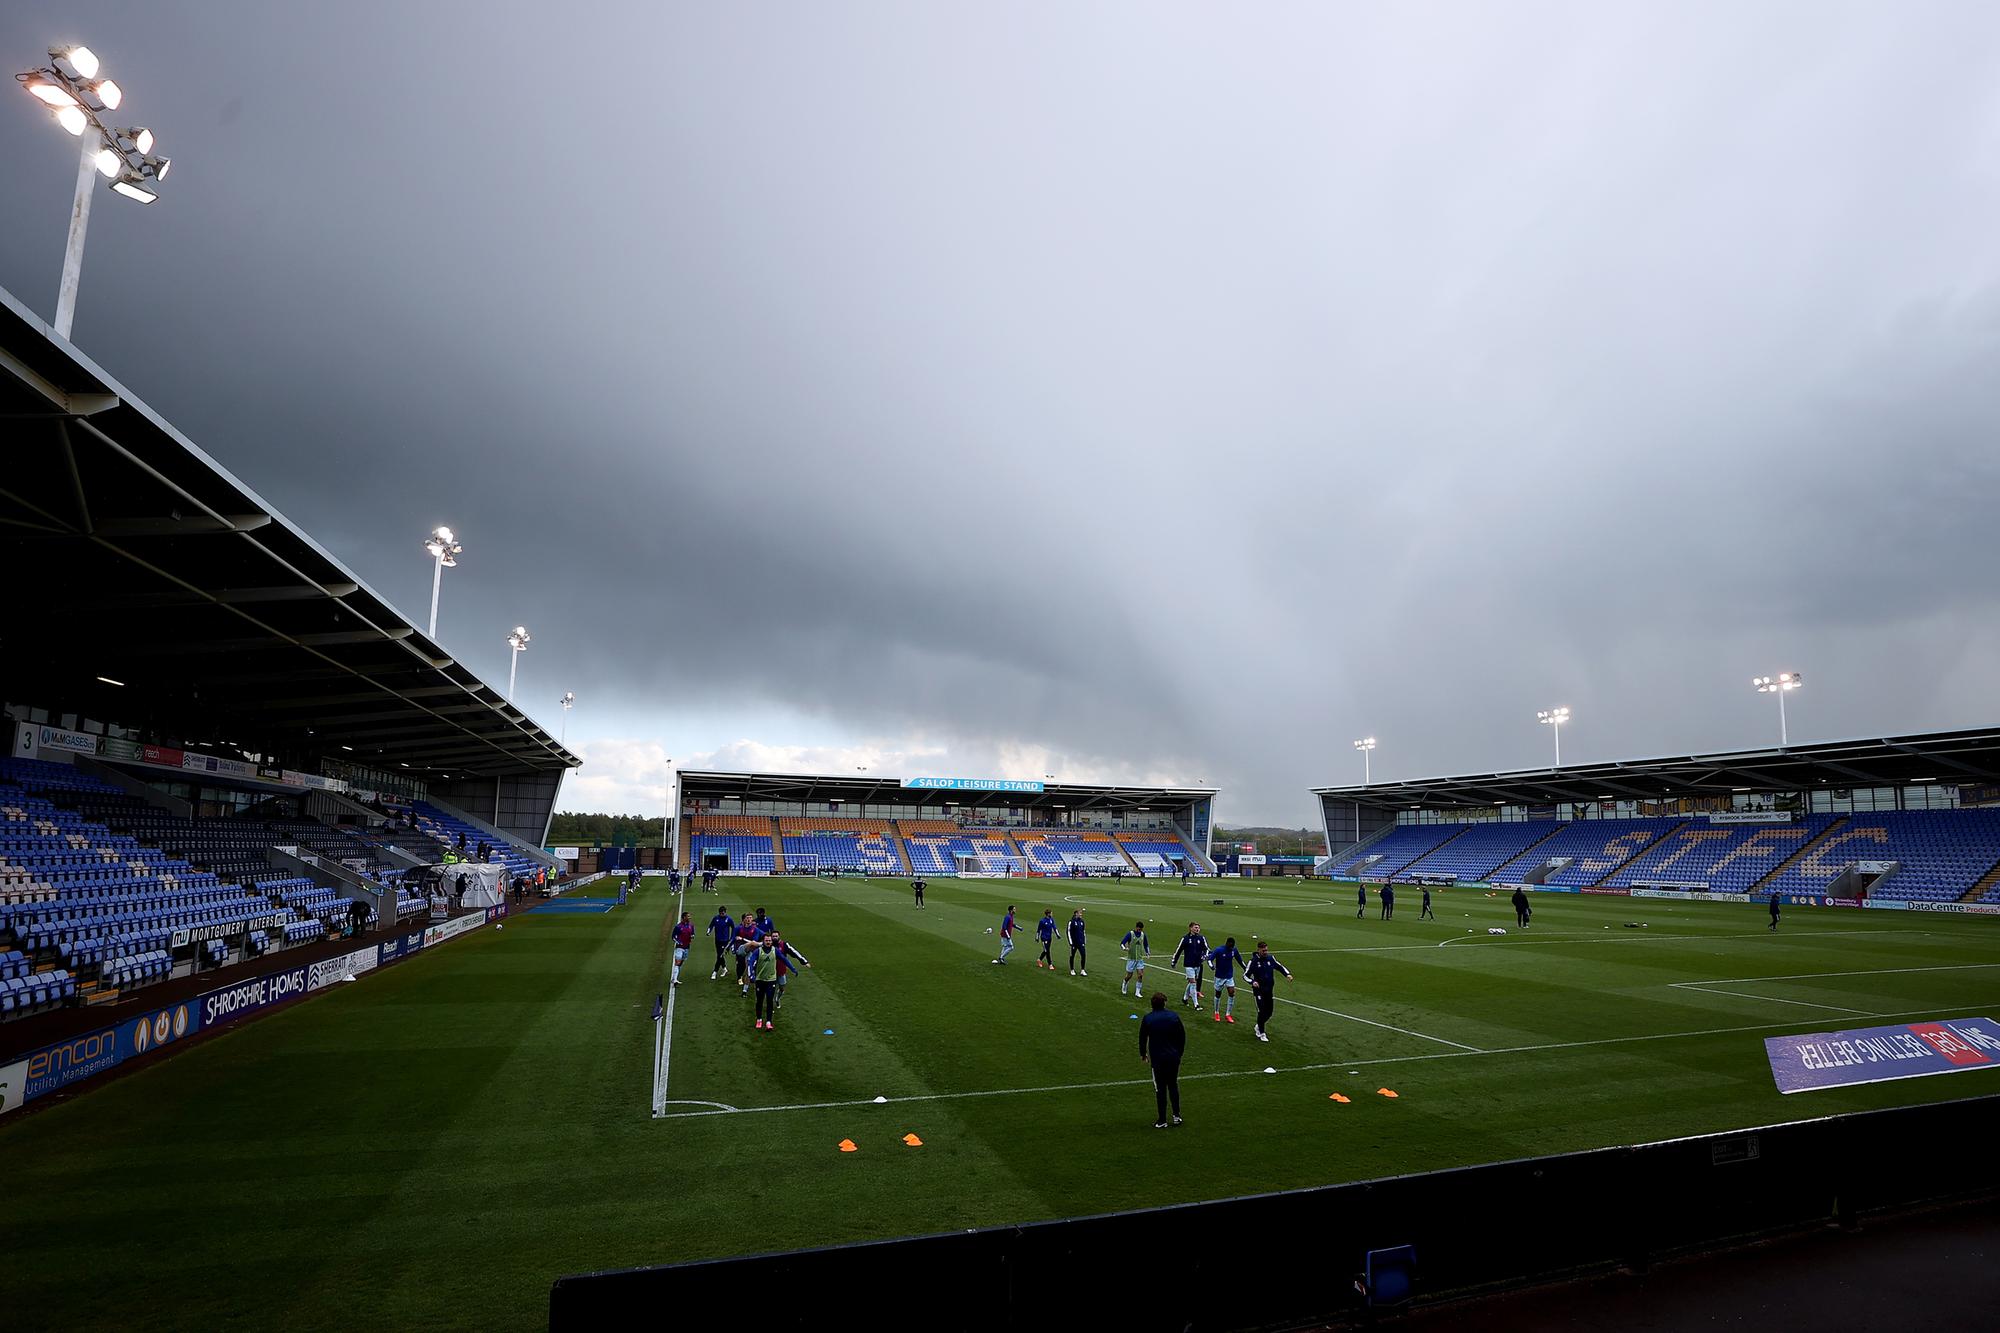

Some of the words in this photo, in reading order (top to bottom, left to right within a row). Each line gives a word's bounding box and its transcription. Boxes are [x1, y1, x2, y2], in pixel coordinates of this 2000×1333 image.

[24, 732, 32, 750] 3
[919, 779, 955, 788] SALOP
[957, 780, 1001, 789] LEISURE
[1004, 781, 1038, 790] STAND
[1942, 785, 1957, 794] 17
[455, 872, 480, 880] TWN
[473, 884, 495, 892] CLUB
[1907, 901, 1965, 913] DataCentre
[1966, 906, 1998, 914] Products
[191, 921, 245, 942] MONTGOMERY
[249, 914, 274, 930] WATERS
[320, 956, 347, 977] SHERRATT
[205, 980, 267, 1025] SHROPSHIRE
[269, 970, 305, 1001] HOMES
[29, 1031, 115, 1079] emcon
[1796, 1040, 1865, 1070] BETTER
[1855, 1033, 1934, 1063] BETTING
[26, 1075, 59, 1096] Utility
[62, 1053, 115, 1083] Management
